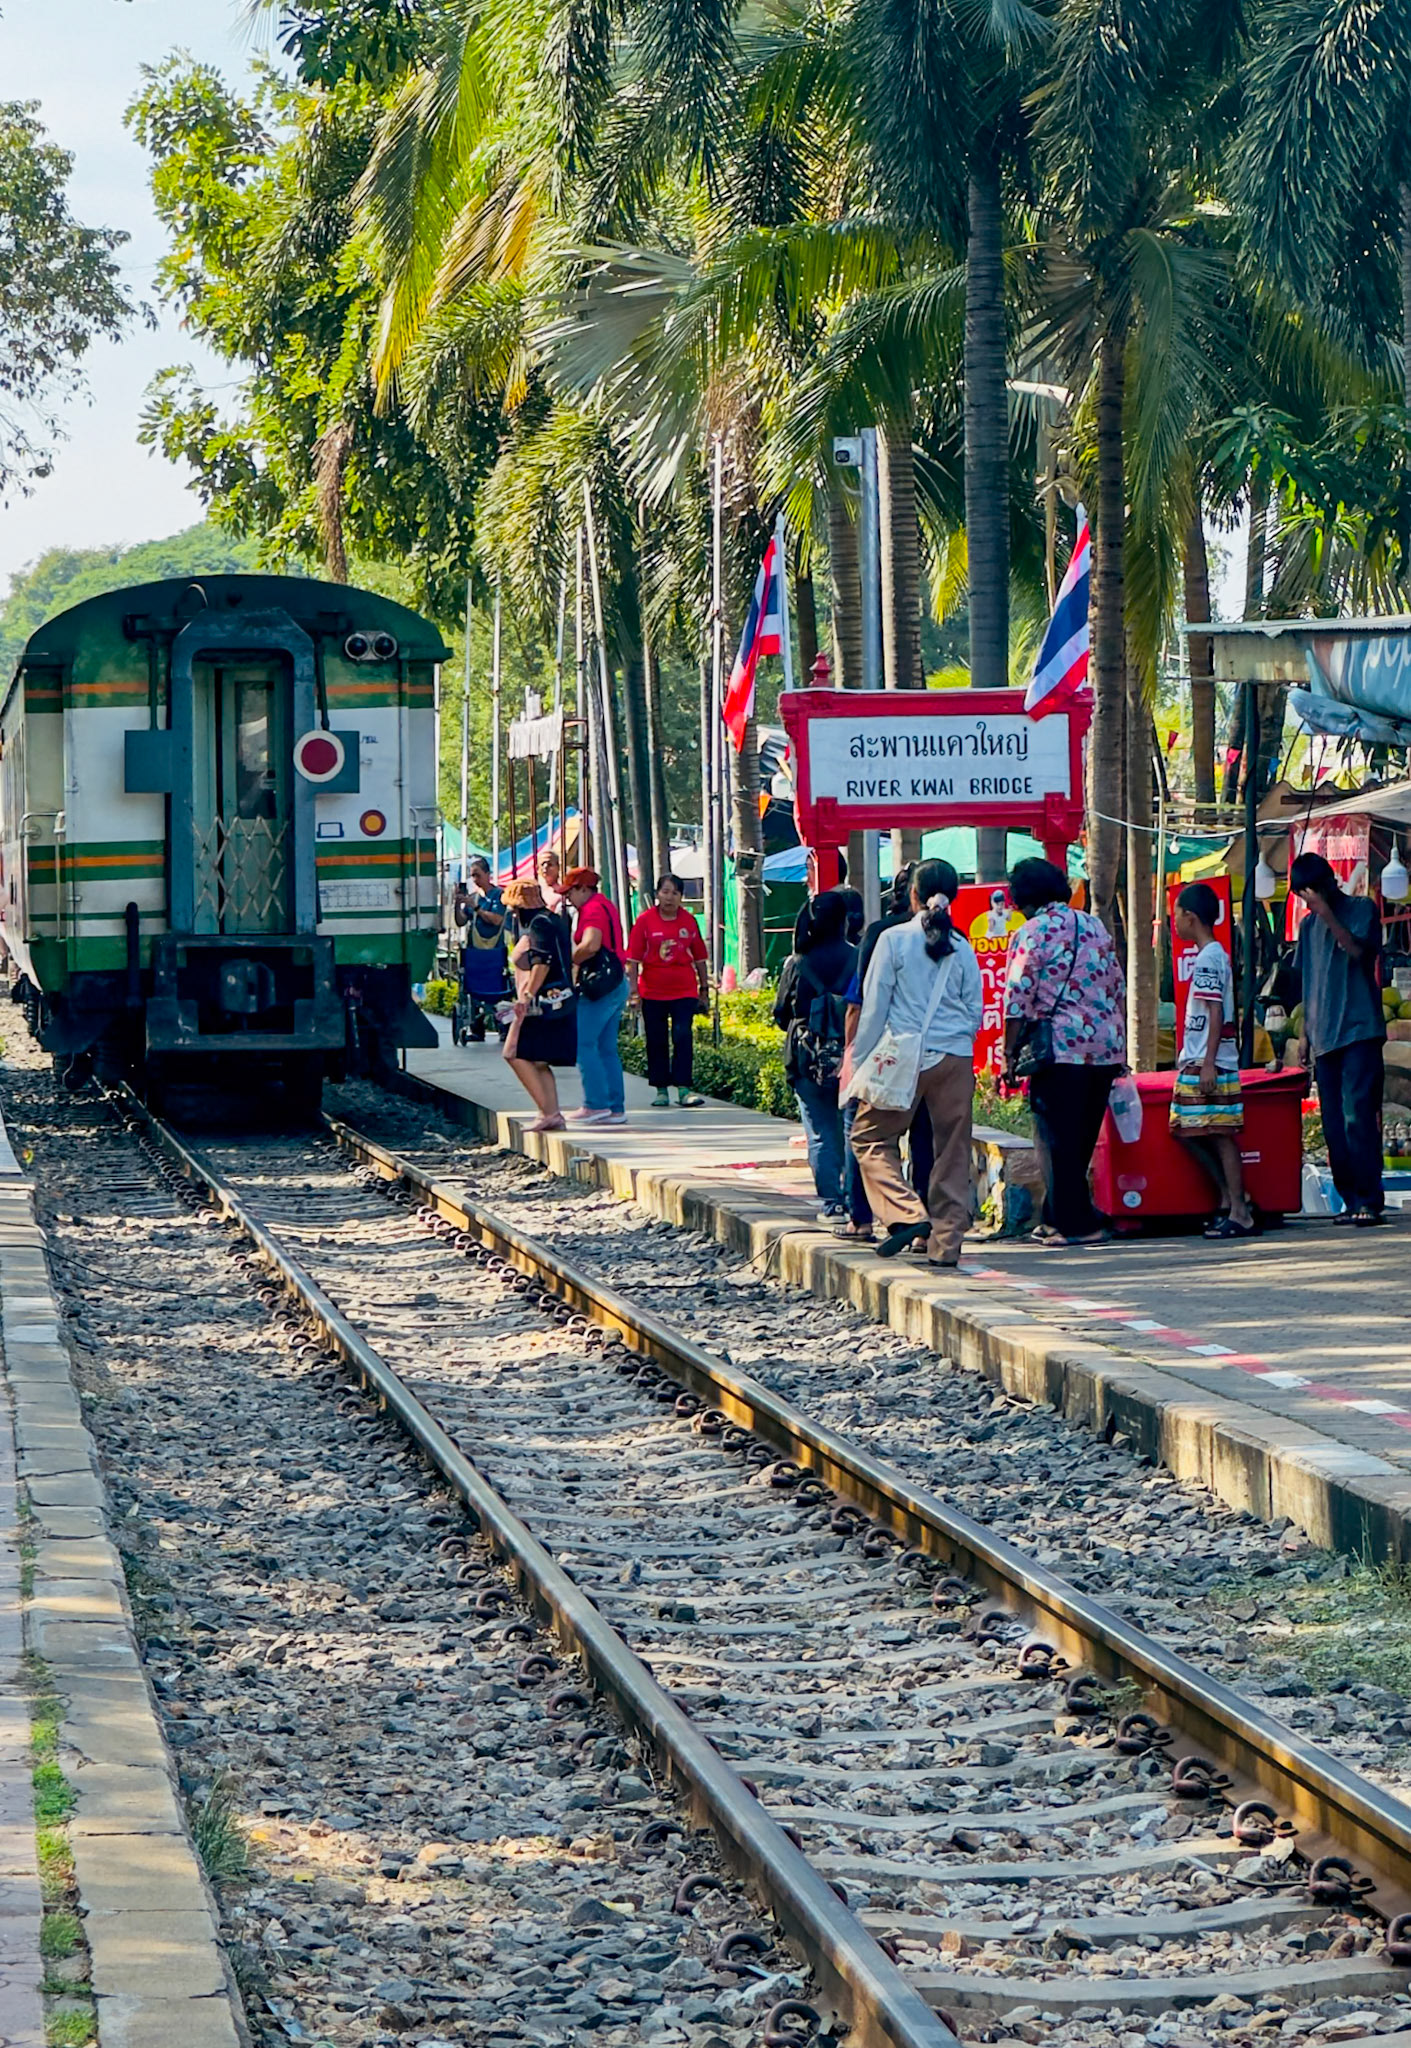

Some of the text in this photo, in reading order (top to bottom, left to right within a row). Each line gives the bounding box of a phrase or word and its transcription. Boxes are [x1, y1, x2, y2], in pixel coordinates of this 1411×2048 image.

[849, 721, 1029, 761] สะพานแควใหญ่
[846, 776, 1033, 797] RIVER KWAI BRIDGE
